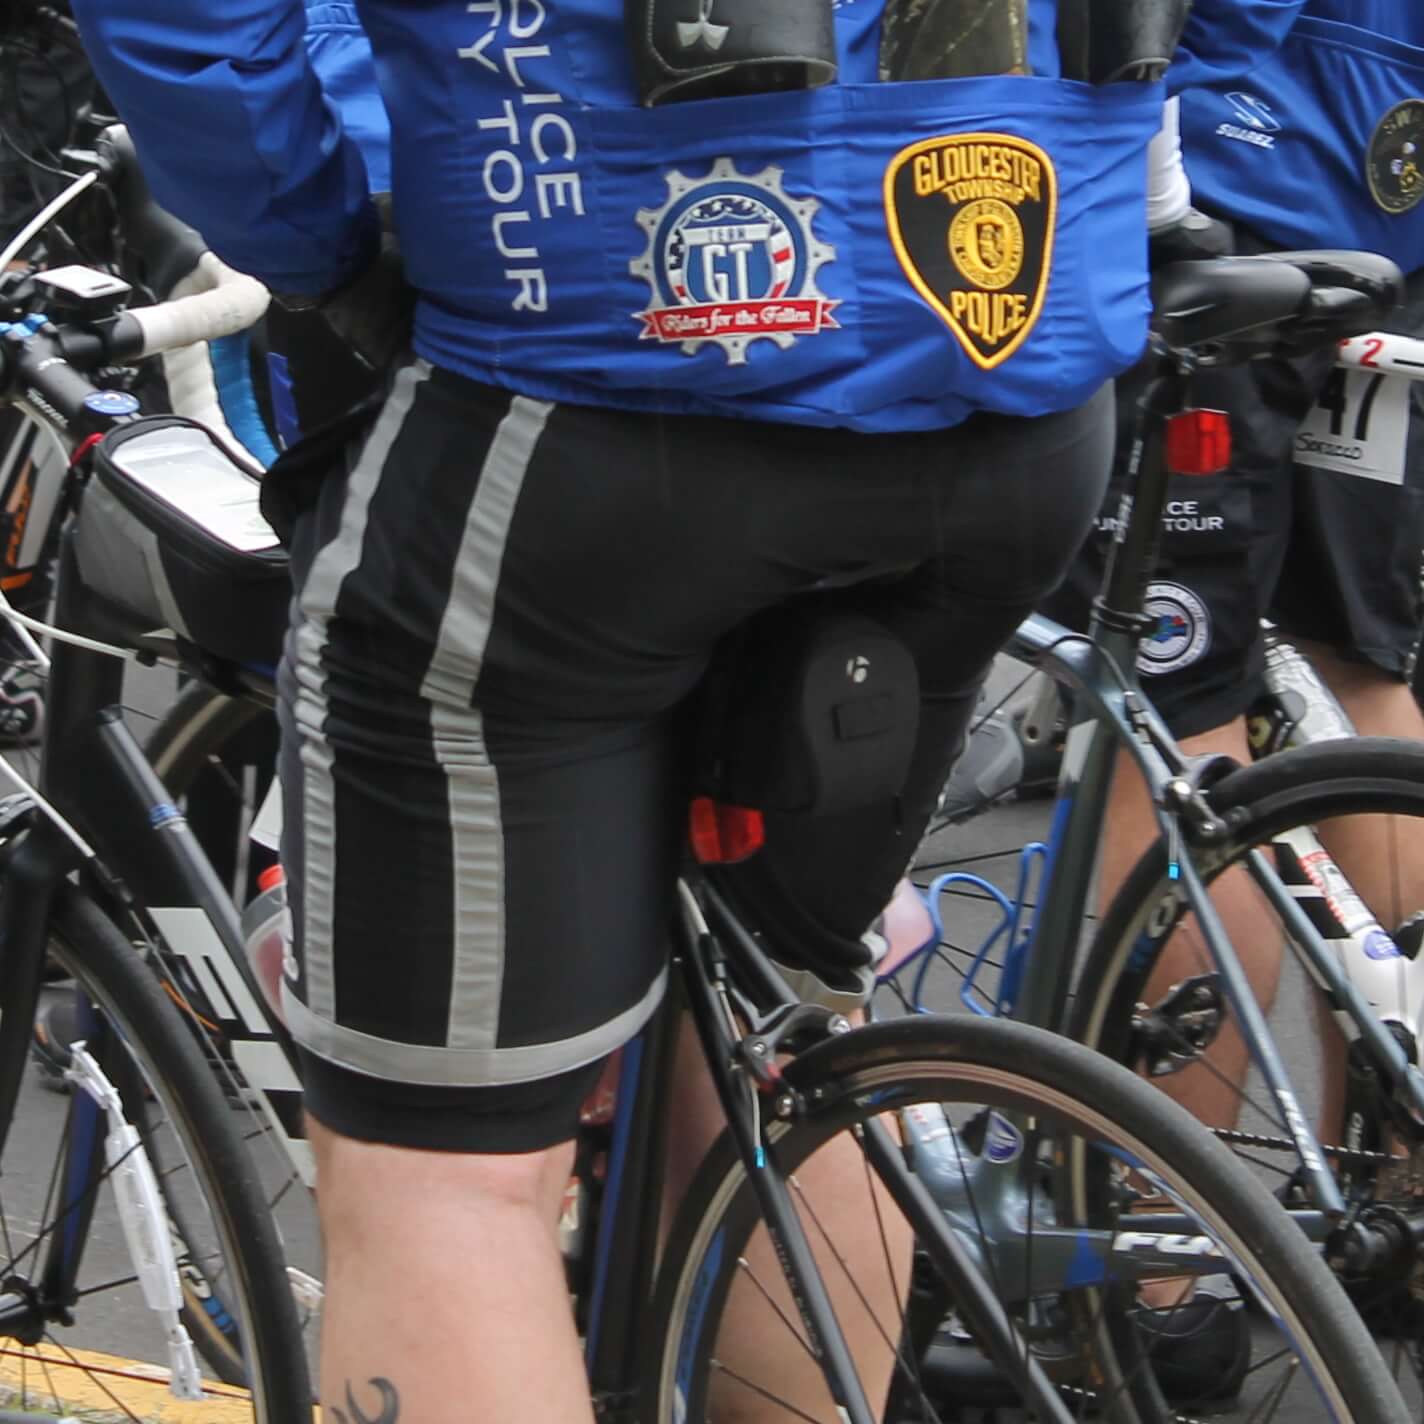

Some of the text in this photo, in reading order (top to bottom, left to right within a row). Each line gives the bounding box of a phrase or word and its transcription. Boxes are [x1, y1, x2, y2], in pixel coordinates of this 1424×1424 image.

[914, 143, 1042, 203] GLOUCESTER
[941, 177, 1027, 206] TOWNSHIP
[476, 98, 550, 314] TOUR
[702, 242, 753, 303] GT
[660, 304, 812, 335] Riders for the Fallen
[950, 290, 1029, 346] POLICE
[1359, 338, 1384, 369] 2
[1161, 515, 1225, 532] TOUR
